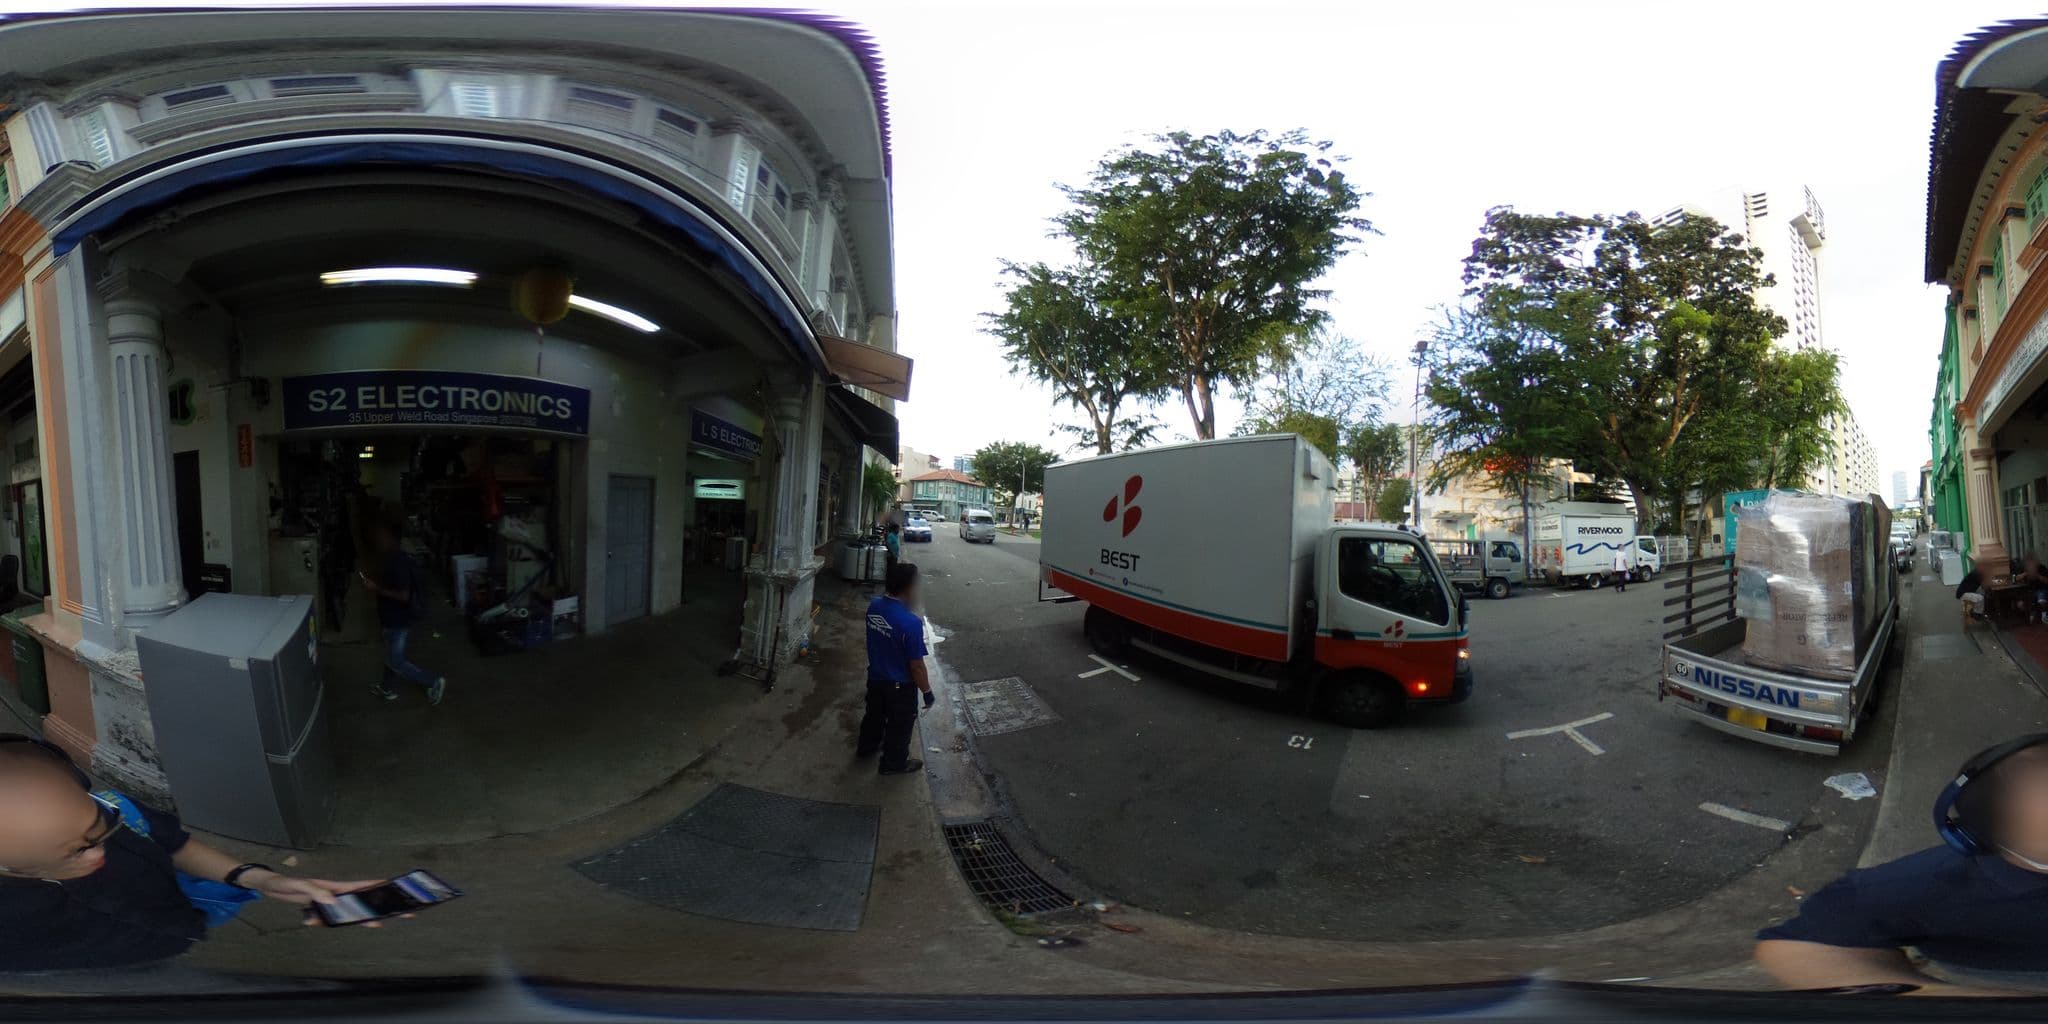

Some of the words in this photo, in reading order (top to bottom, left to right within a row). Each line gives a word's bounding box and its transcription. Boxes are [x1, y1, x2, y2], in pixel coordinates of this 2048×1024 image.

[307, 386, 348, 413] S2
[348, 412, 362, 424] 35
[363, 412, 394, 425] Upper
[424, 411, 449, 423] Road
[710, 425, 718, 440] S
[1577, 526, 1624, 536] RIVERWOOD
[1100, 548, 1141, 572] BEST
[1676, 663, 1688, 675] 60
[1694, 666, 1800, 708] NISSAN
